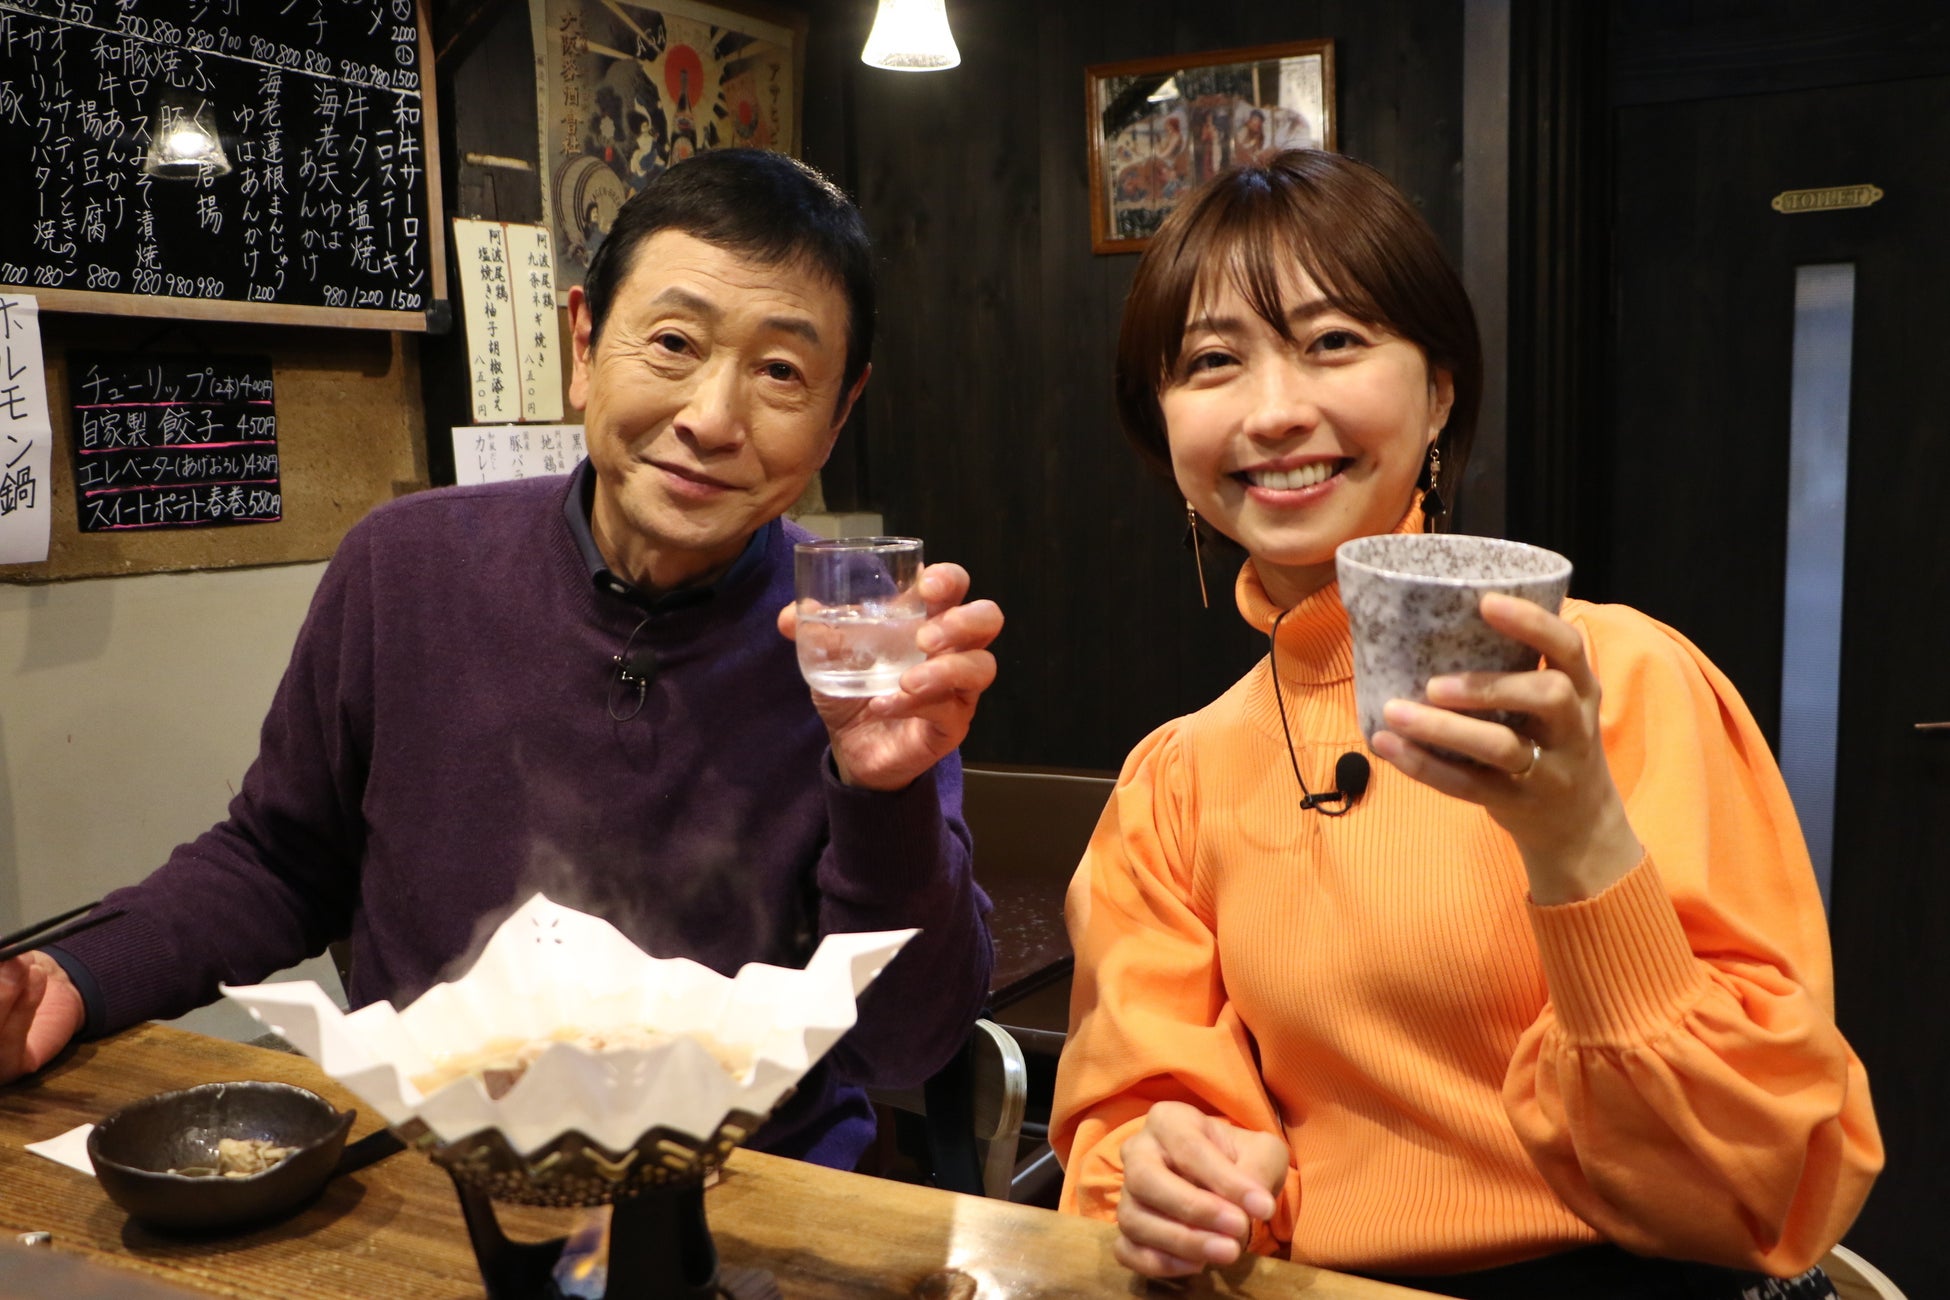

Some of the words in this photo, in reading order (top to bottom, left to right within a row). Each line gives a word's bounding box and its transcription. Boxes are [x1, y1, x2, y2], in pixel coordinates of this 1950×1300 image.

[116, 12, 149, 38] 500
[153, 18, 182, 44] 880
[185, 26, 215, 50] 980
[219, 26, 242, 53] 900
[250, 35, 276, 61] 980
[275, 43, 302, 67] 800
[304, 49, 332, 74] 880
[340, 60, 368, 82] 980
[369, 64, 391, 88] 980
[392, 68, 419, 89] 1.500
[22, 26, 64, 254] ガーリックバター焼
[343, 87, 381, 274] 牛タン塩焼
[393, 93, 424, 288] 和牛サーロイン
[1786, 189, 1864, 209] TOILET
[300, 147, 319, 282] あんかけ
[1, 263, 29, 285] 700
[33, 265, 65, 286] 780
[86, 264, 121, 289] 880
[132, 268, 162, 294] 980
[165, 273, 194, 297] 980
[196, 276, 225, 298] 980
[323, 285, 348, 306] 980
[350, 286, 385, 308] 1.200
[390, 289, 422, 310] 1.500
